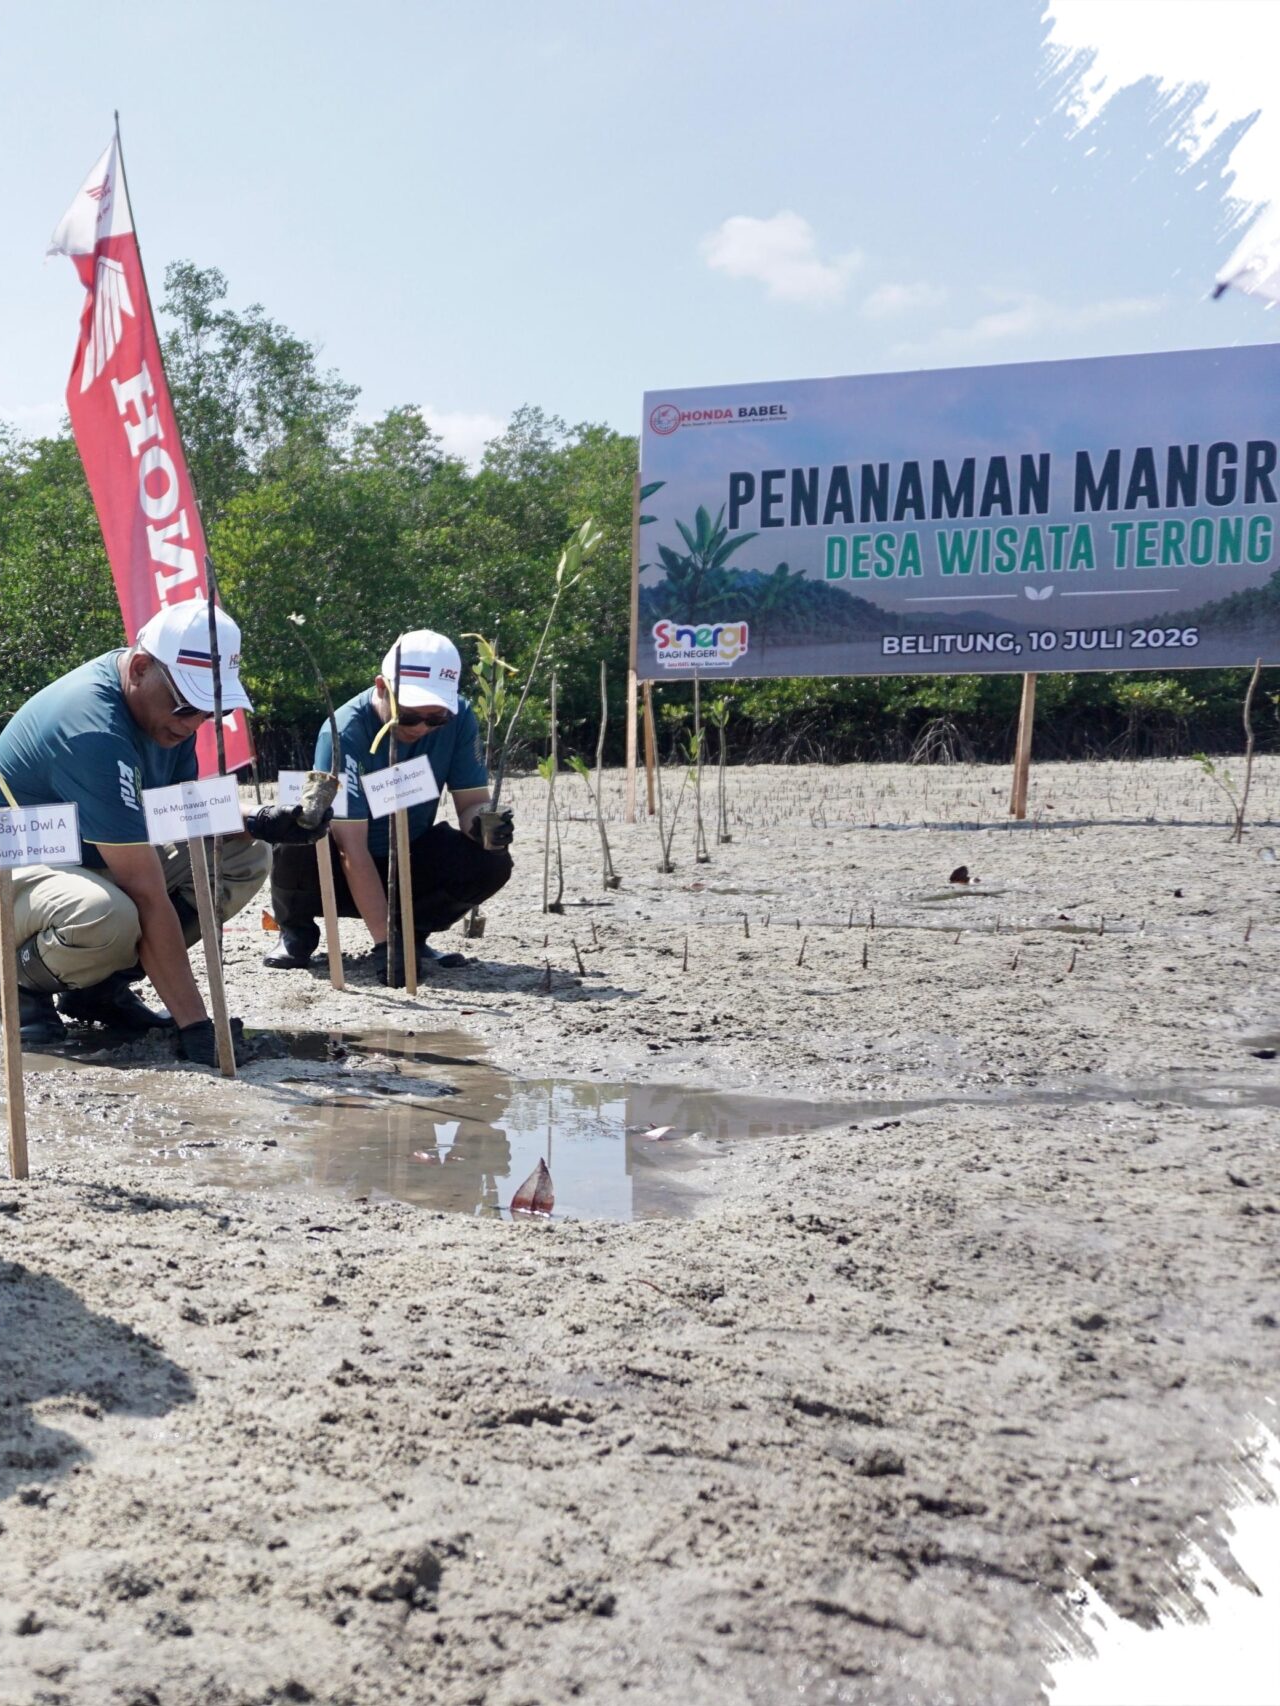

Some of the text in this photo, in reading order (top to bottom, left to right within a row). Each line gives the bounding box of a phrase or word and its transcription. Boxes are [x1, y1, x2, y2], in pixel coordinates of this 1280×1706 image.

[681, 404, 787, 421] HONDA BABEL
[728, 440, 1279, 530] PENANAMAN MANGR
[825, 515, 1273, 581] DESA WISATA TERONG
[882, 628, 1199, 655] BELITUNG, 10 JULI 2026
[659, 650, 718, 659] BAGI NEGERI
[370, 783, 384, 792] Bpk
[385, 777, 402, 787] Febri
[153, 795, 231, 816] Bpk Munawar Chalil
[57, 818, 66, 830] A
[27, 845, 65, 856] Perkasa
